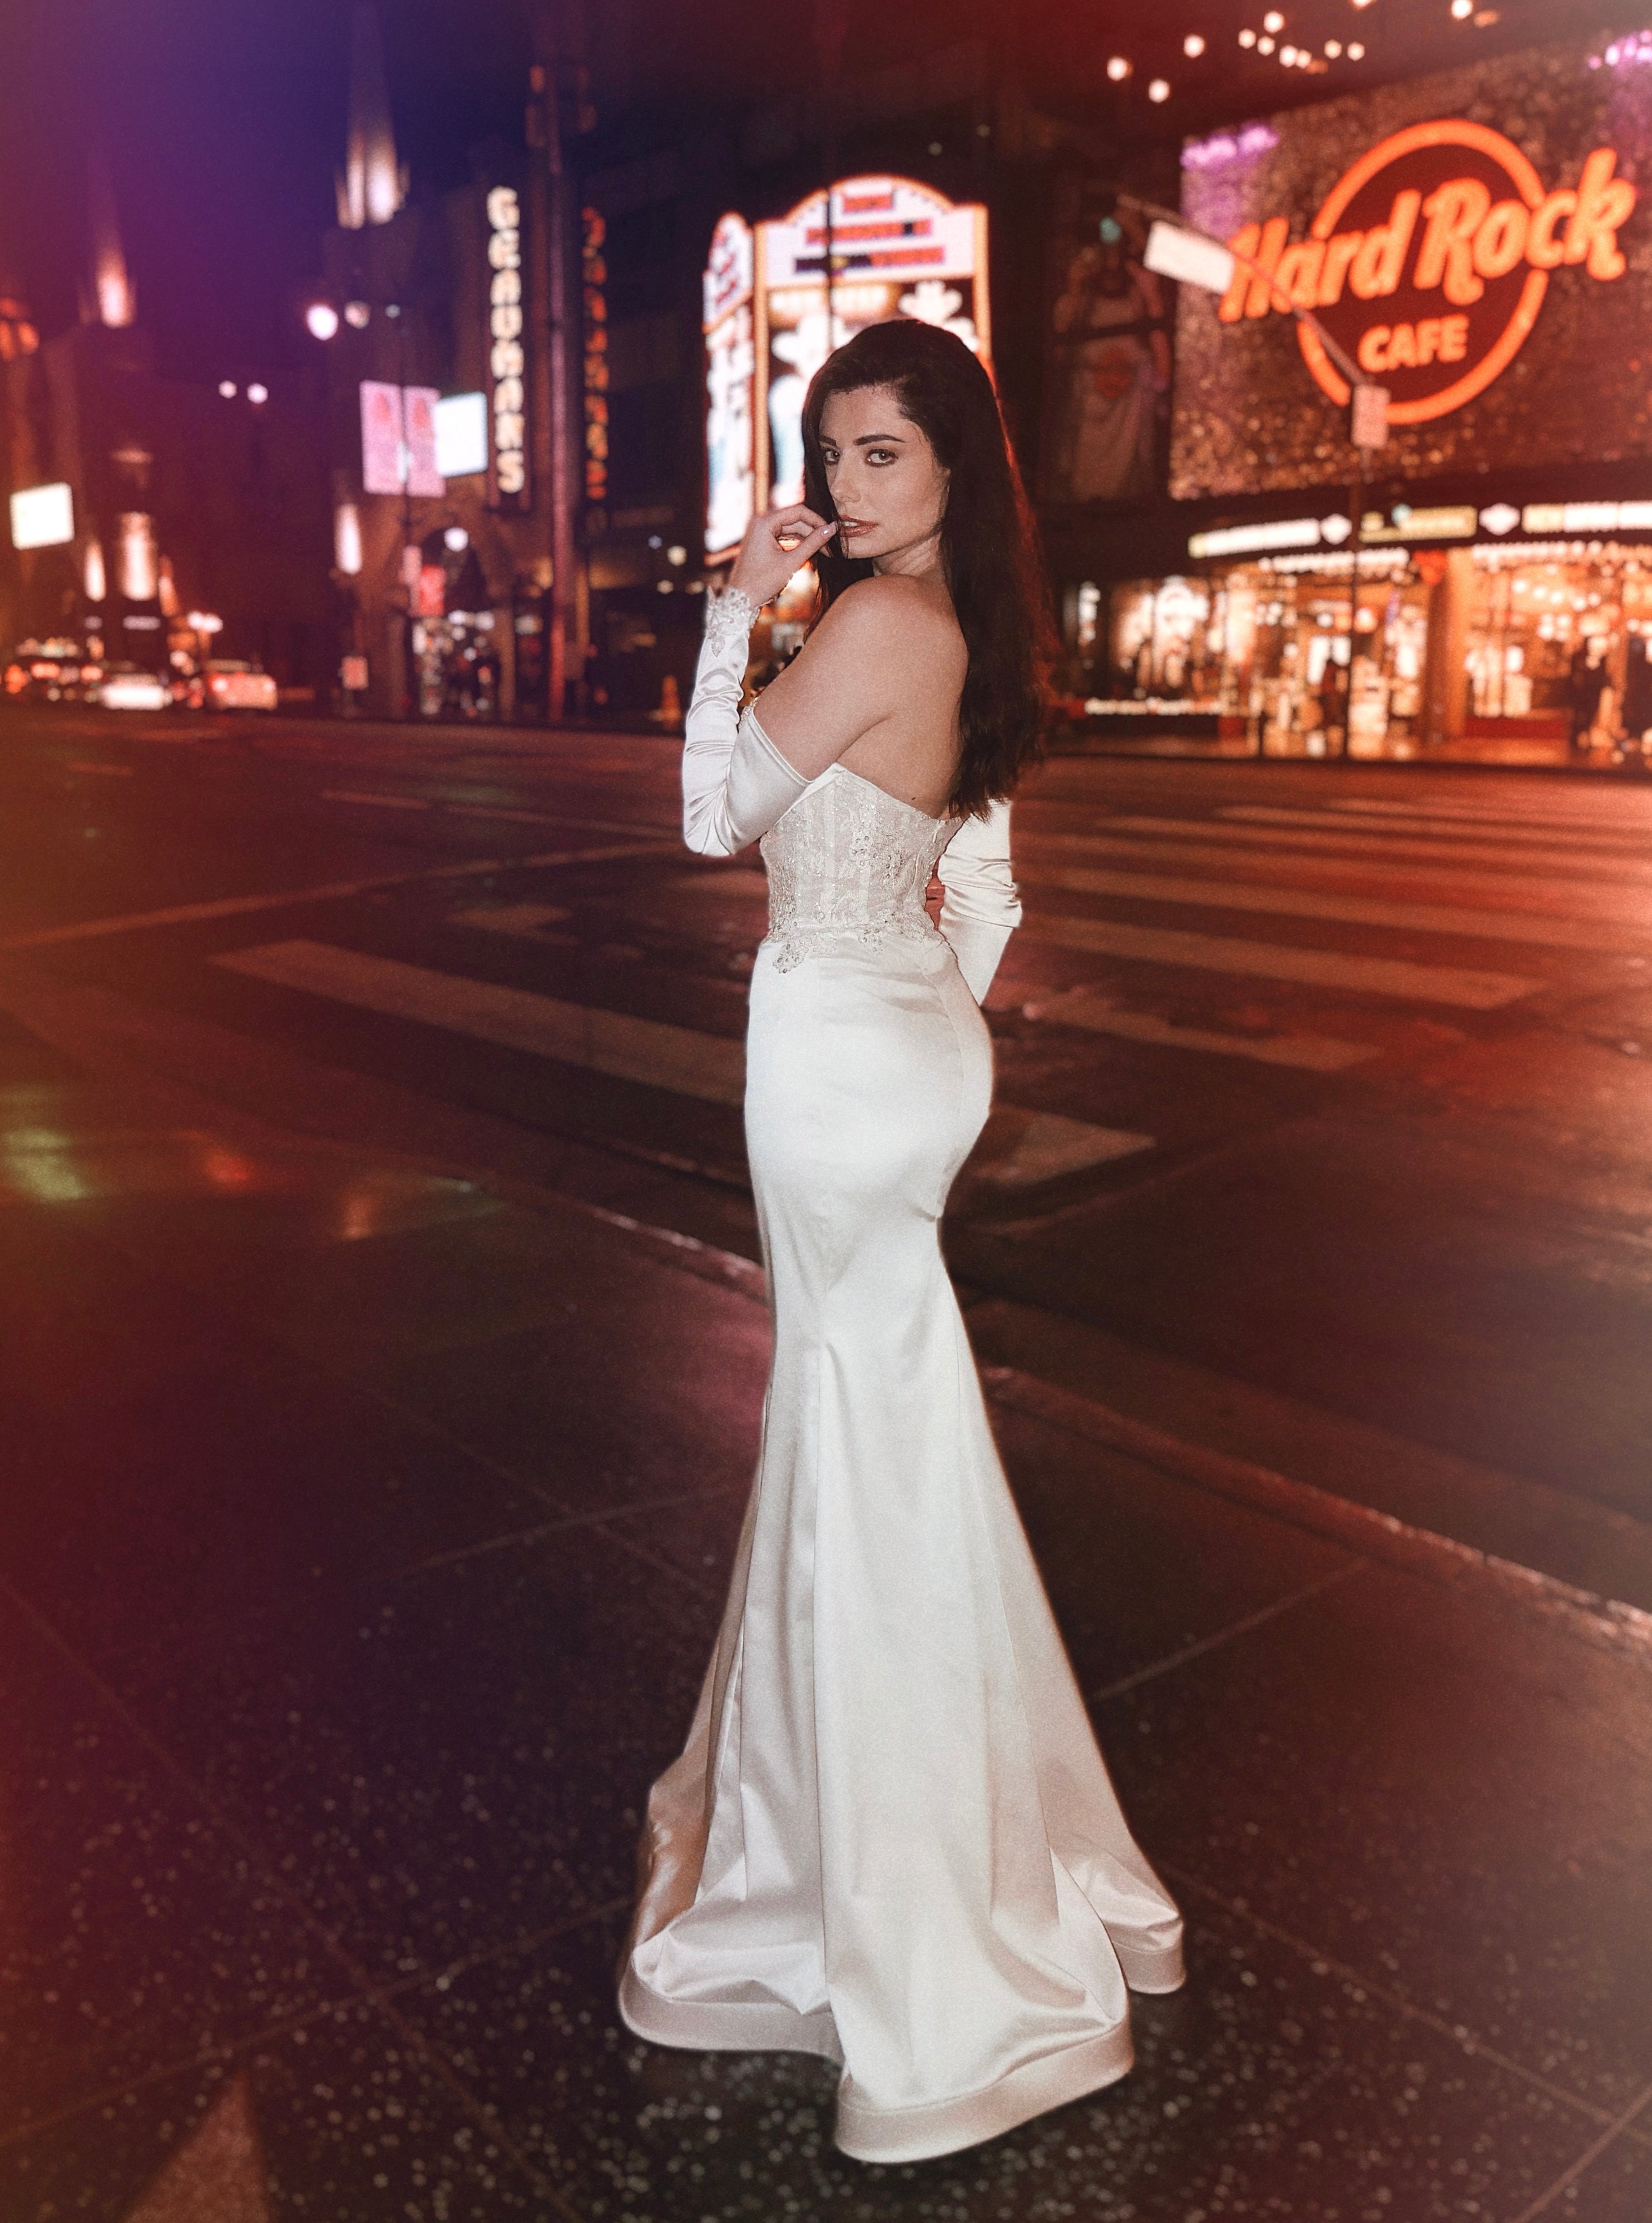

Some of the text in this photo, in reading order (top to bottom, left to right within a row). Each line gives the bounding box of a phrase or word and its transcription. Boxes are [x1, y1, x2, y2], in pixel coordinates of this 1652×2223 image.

[1218, 147, 1638, 324] Hard Rock
[1357, 313, 1471, 373] CAFE
